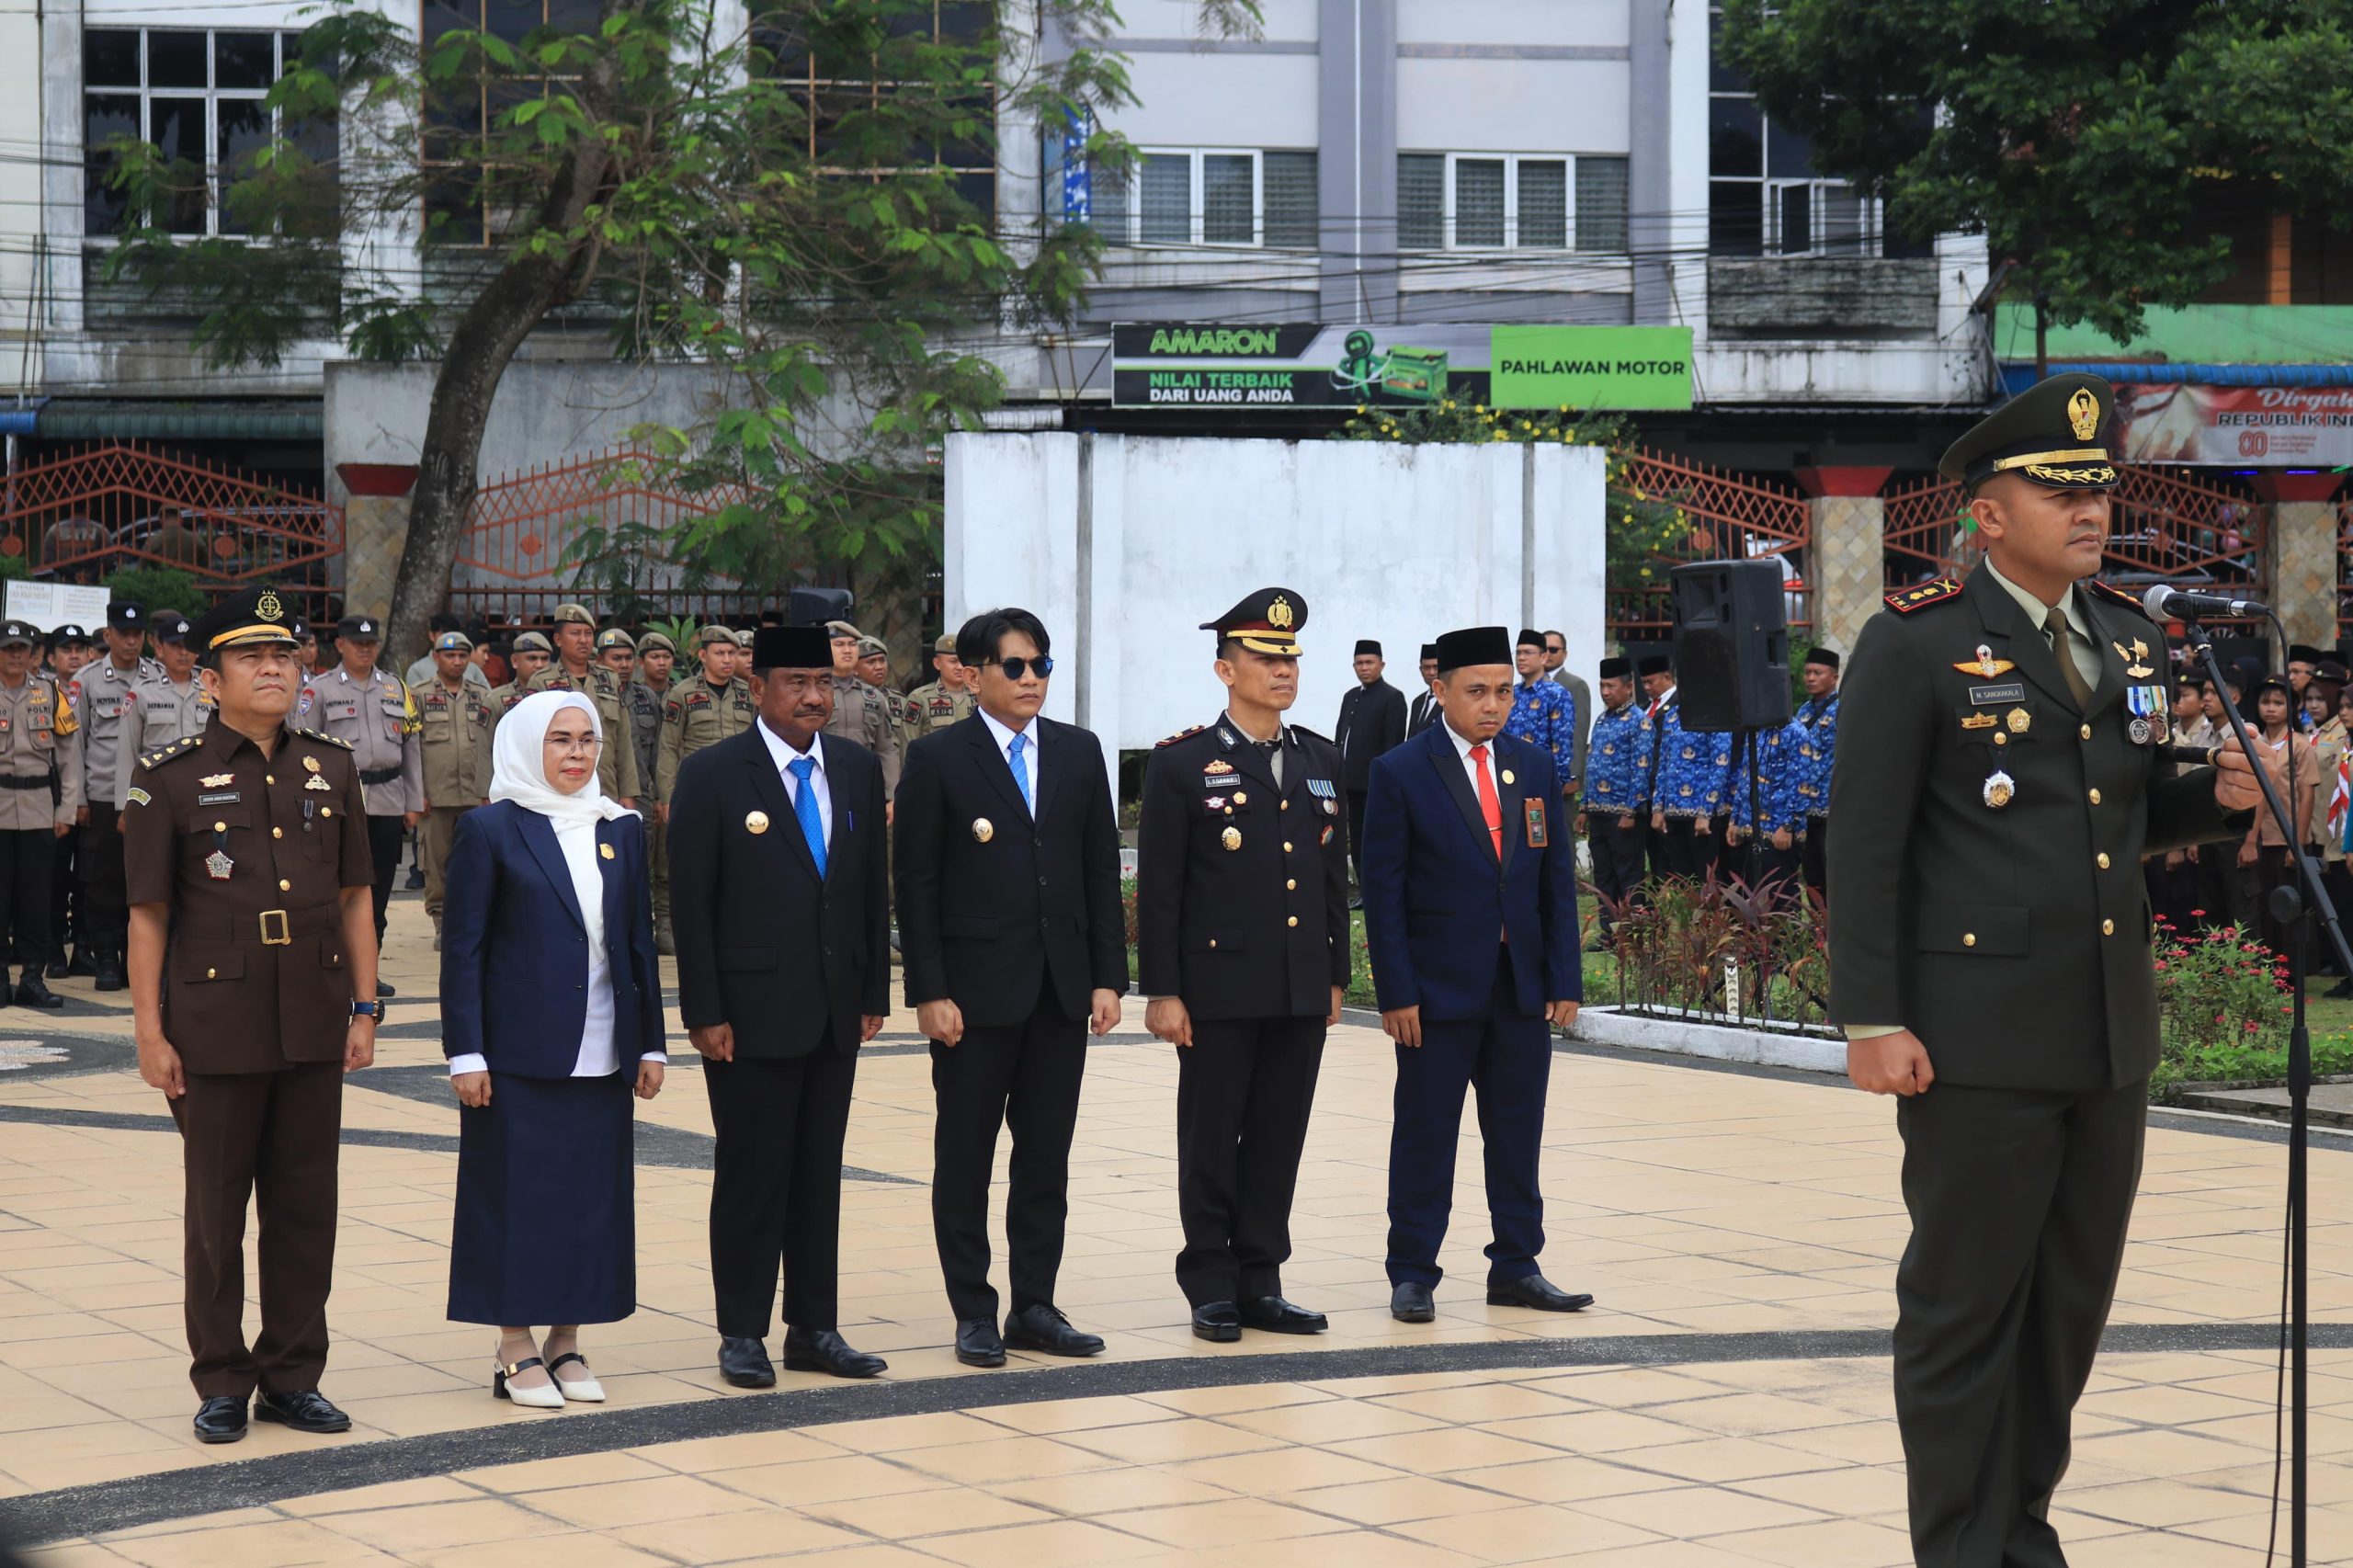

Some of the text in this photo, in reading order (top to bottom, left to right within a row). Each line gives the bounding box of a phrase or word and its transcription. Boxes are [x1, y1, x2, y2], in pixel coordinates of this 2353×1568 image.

[1150, 329, 1277, 354] AMARON
[1501, 360, 1685, 375] PAHLAWAN MOTOR
[1150, 373, 1294, 388] NILAI TERBAIK
[1150, 389, 1294, 403] DARI UANG ANDA
[2218, 413, 2322, 427] REPUBLIK
[1892, 596, 1911, 608] TNI
[28, 706, 51, 714] POLRI
